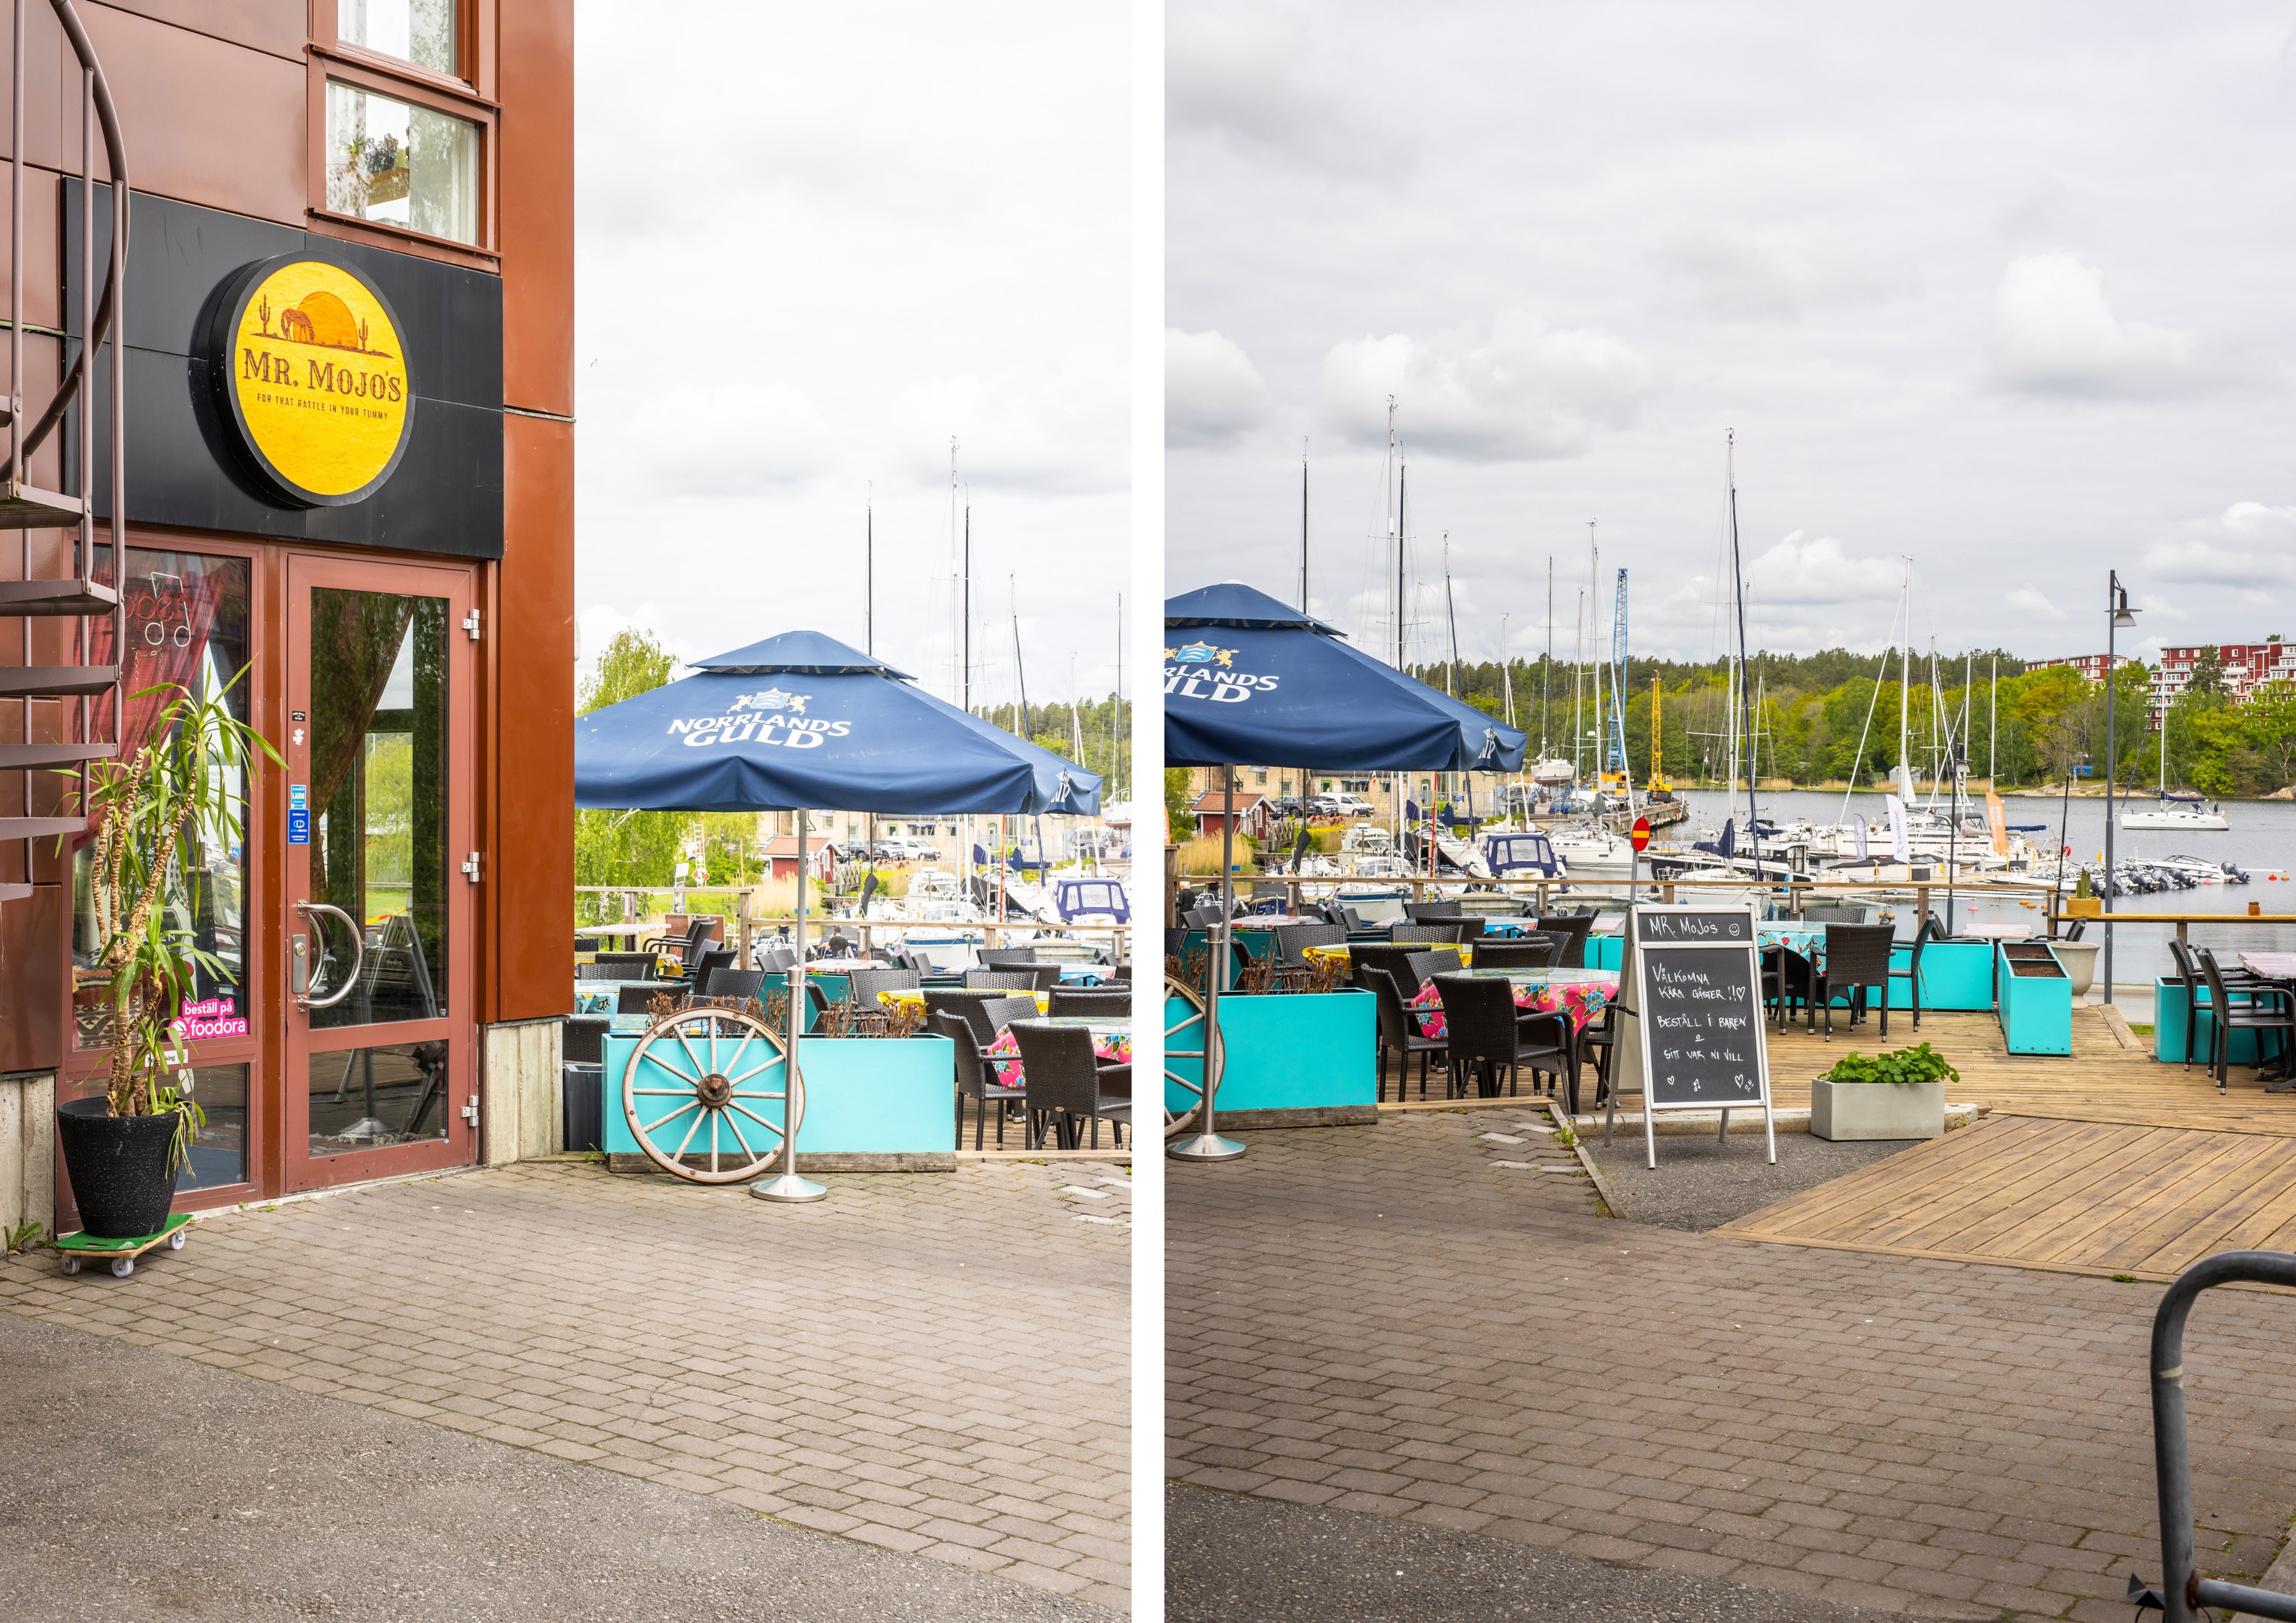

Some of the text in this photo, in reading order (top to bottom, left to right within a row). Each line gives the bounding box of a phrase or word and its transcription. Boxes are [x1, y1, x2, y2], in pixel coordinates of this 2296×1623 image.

[243, 348, 401, 402] MR. MOJO'S
[257, 392, 388, 420] FOR THAT RATTLE IN YOUR TUMMY
[1164, 664, 1280, 691] RLANDS
[666, 711, 852, 736] NORRLANDS
[683, 722, 824, 749] GULD
[1649, 915, 1677, 938] MR.
[1659, 985, 1685, 999] KÄRA
[184, 1000, 232, 1015] beställ på
[190, 1017, 246, 1036] foodora
[1656, 1013, 1702, 1029] BESTÄLL
[1718, 1015, 1747, 1029] BAREN
[1686, 1050, 1707, 1063] VAR
[1711, 1049, 1720, 1060] NI
[1723, 1047, 1744, 1062] VILL
